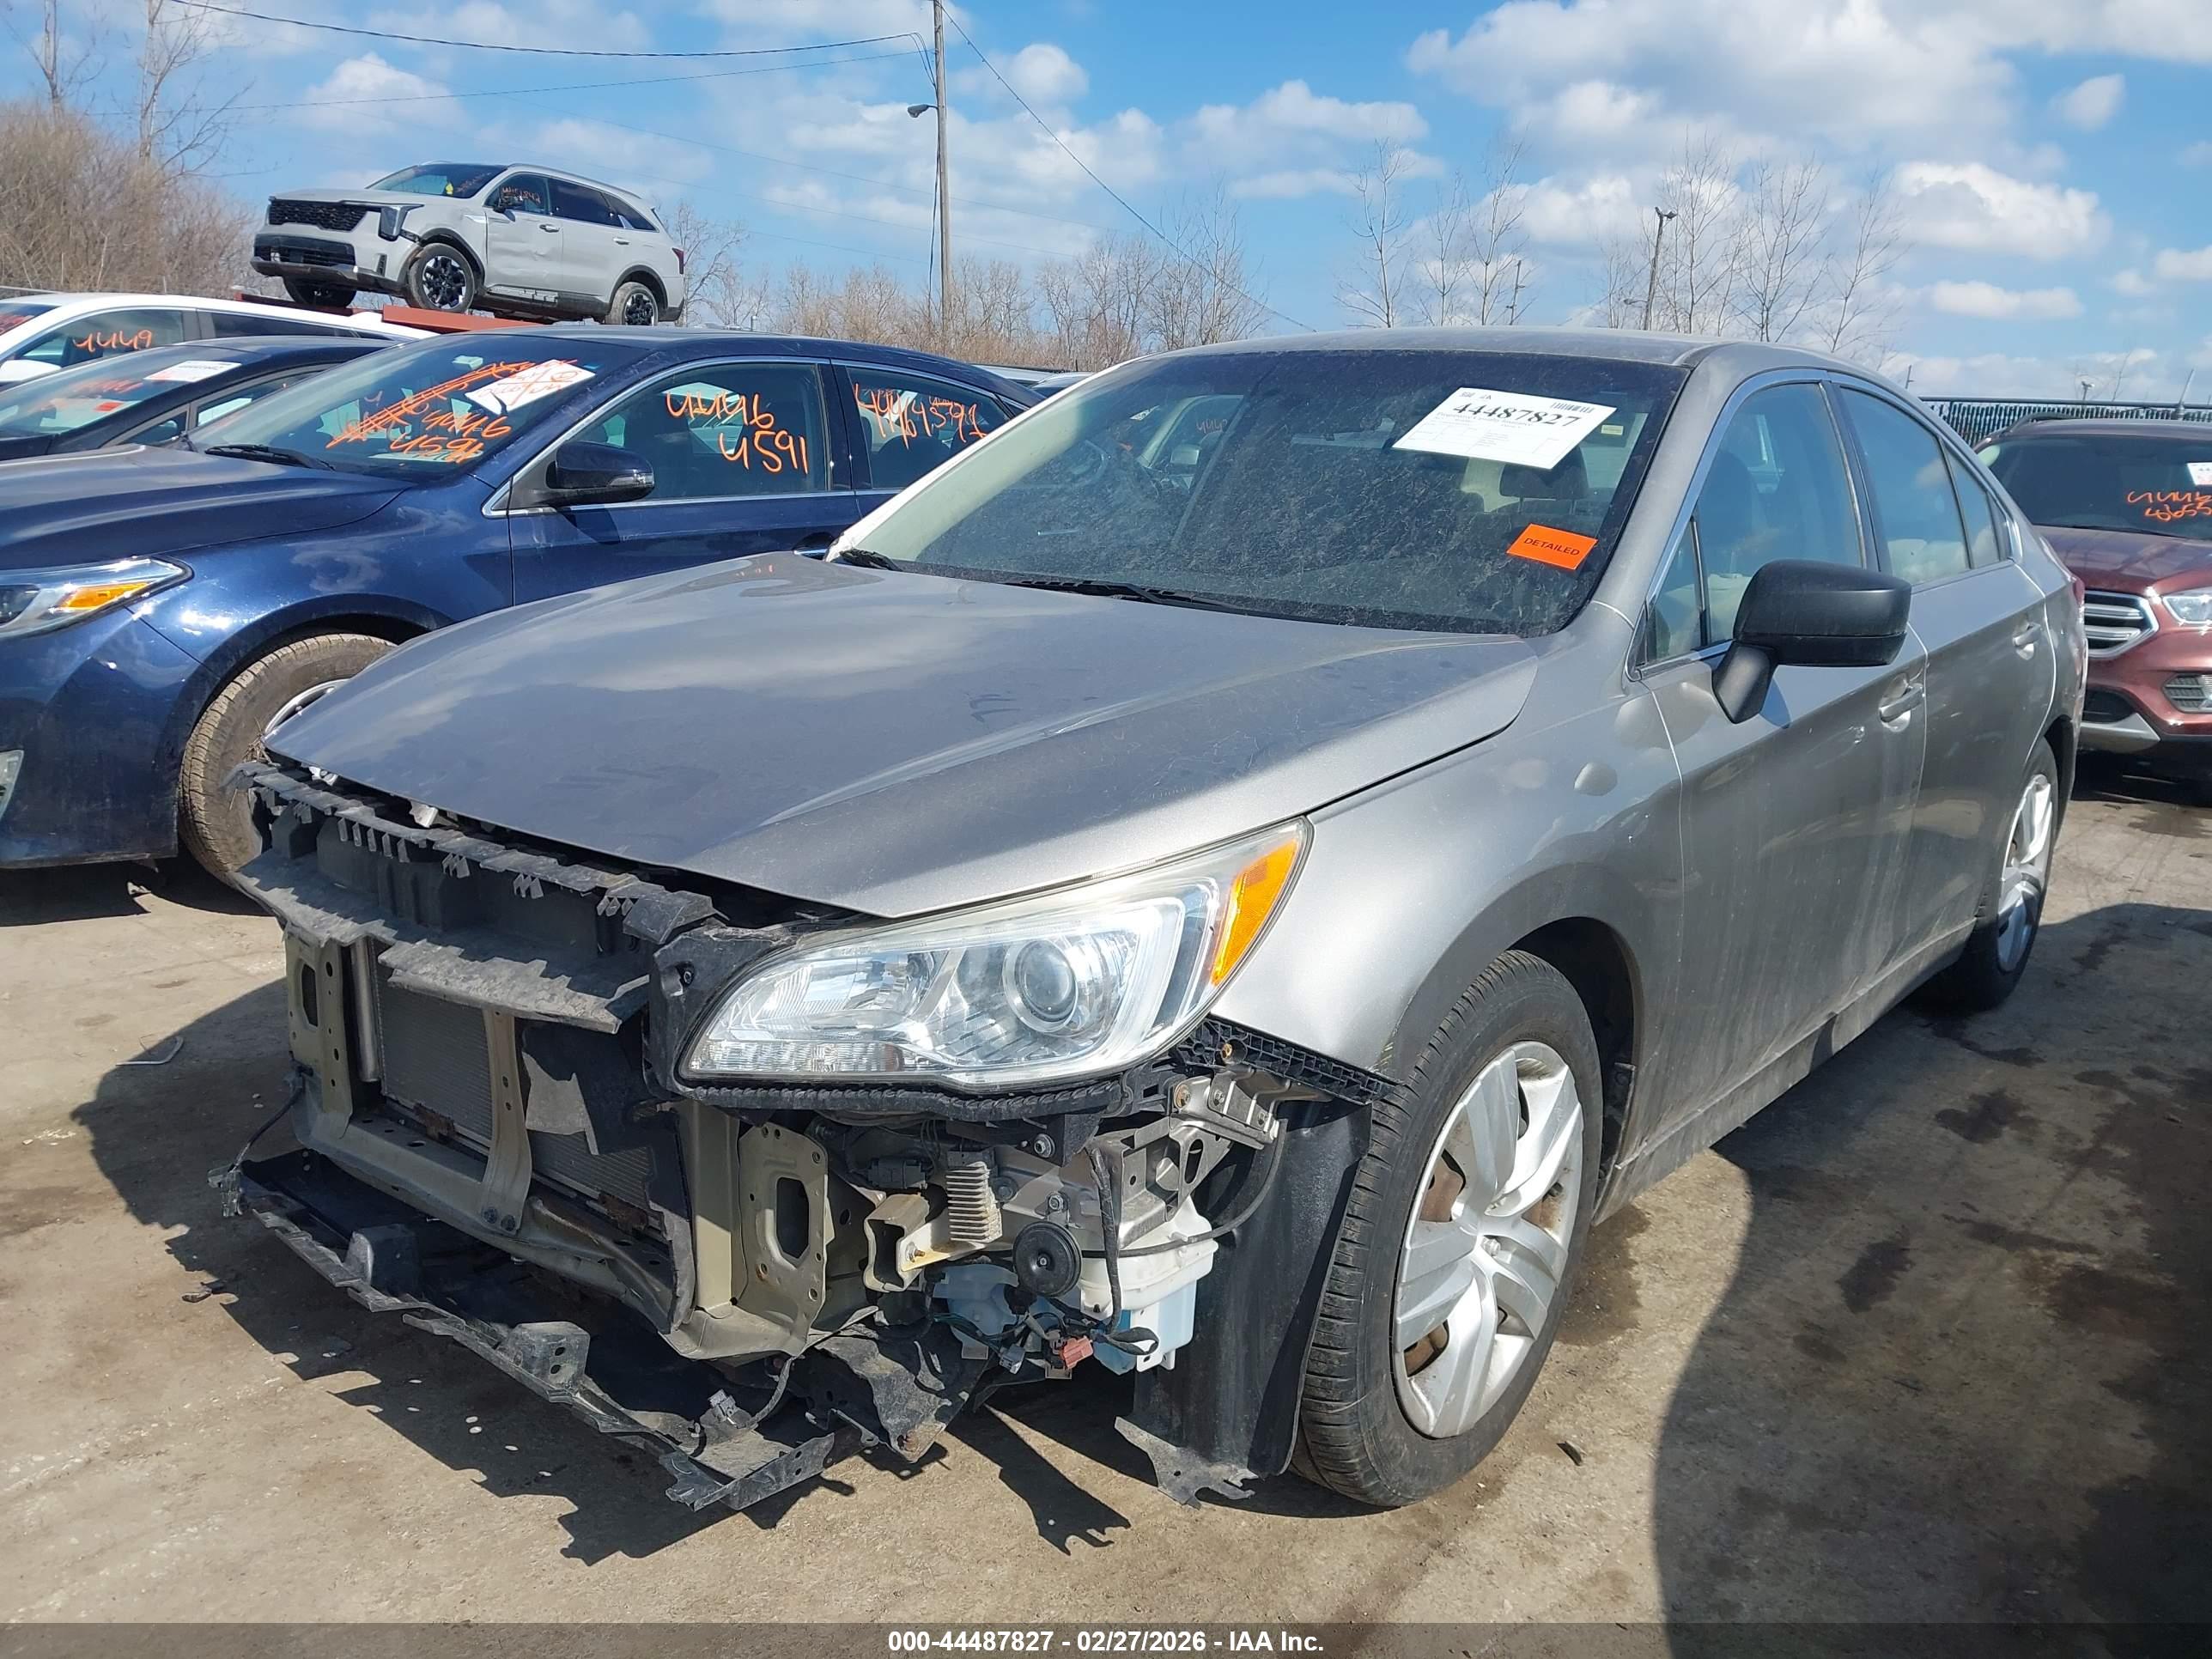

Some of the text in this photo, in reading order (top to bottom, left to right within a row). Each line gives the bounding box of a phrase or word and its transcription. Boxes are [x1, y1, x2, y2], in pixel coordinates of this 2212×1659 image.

[72, 329, 153, 353] 4449
[665, 391, 775, 429] 4446
[1452, 403, 1582, 428] 44487827
[719, 429, 809, 475] 4591
[1523, 537, 1581, 556] DETAILED
